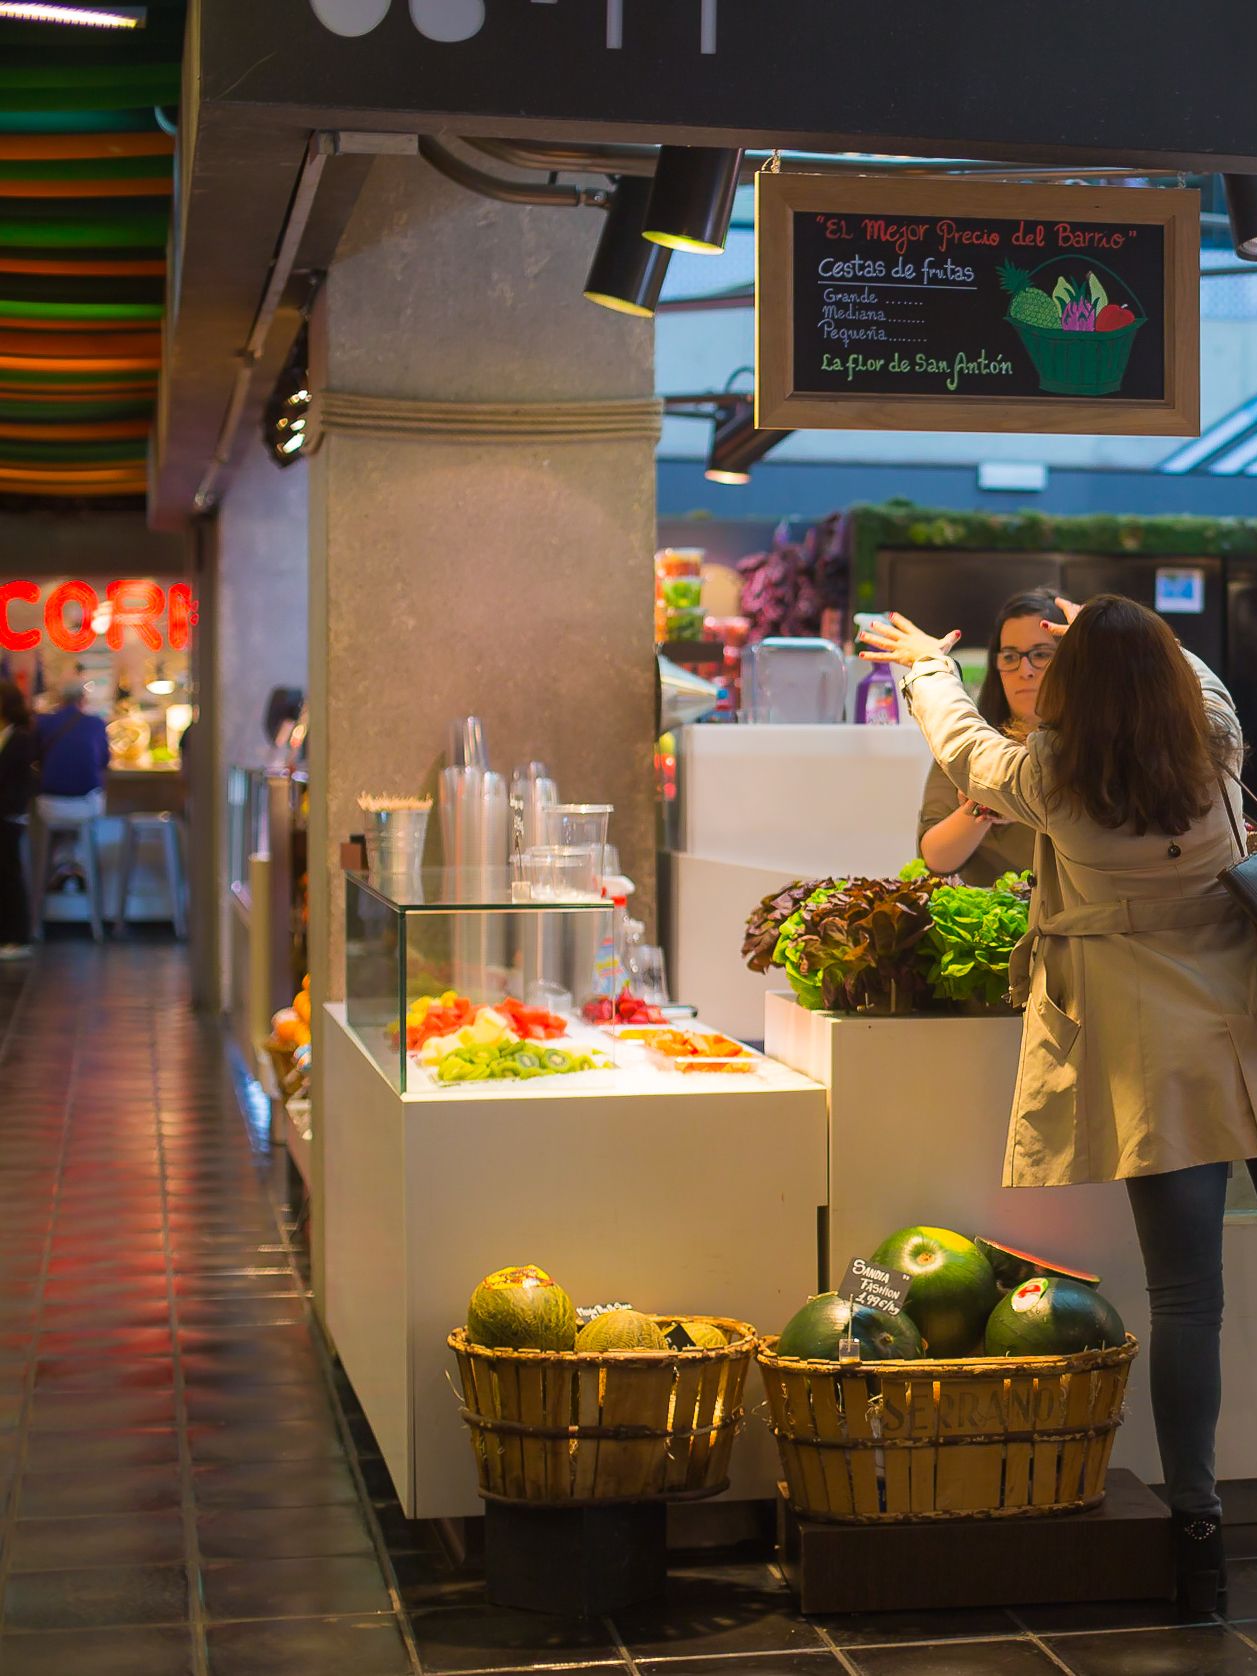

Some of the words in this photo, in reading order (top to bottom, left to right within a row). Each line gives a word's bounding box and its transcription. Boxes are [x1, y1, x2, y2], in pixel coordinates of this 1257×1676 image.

[936, 219, 1001, 252] Precio
[1011, 219, 1046, 247] del
[817, 253, 887, 278] Cestas
[891, 255, 917, 279] de
[921, 257, 975, 285] frutas
[820, 353, 844, 371] La
[888, 352, 911, 373] de
[914, 353, 951, 373] San
[946, 349, 1013, 391] Antón
[852, 1258, 890, 1284] SANDIA
[884, 1385, 1055, 1432] SERRANO
